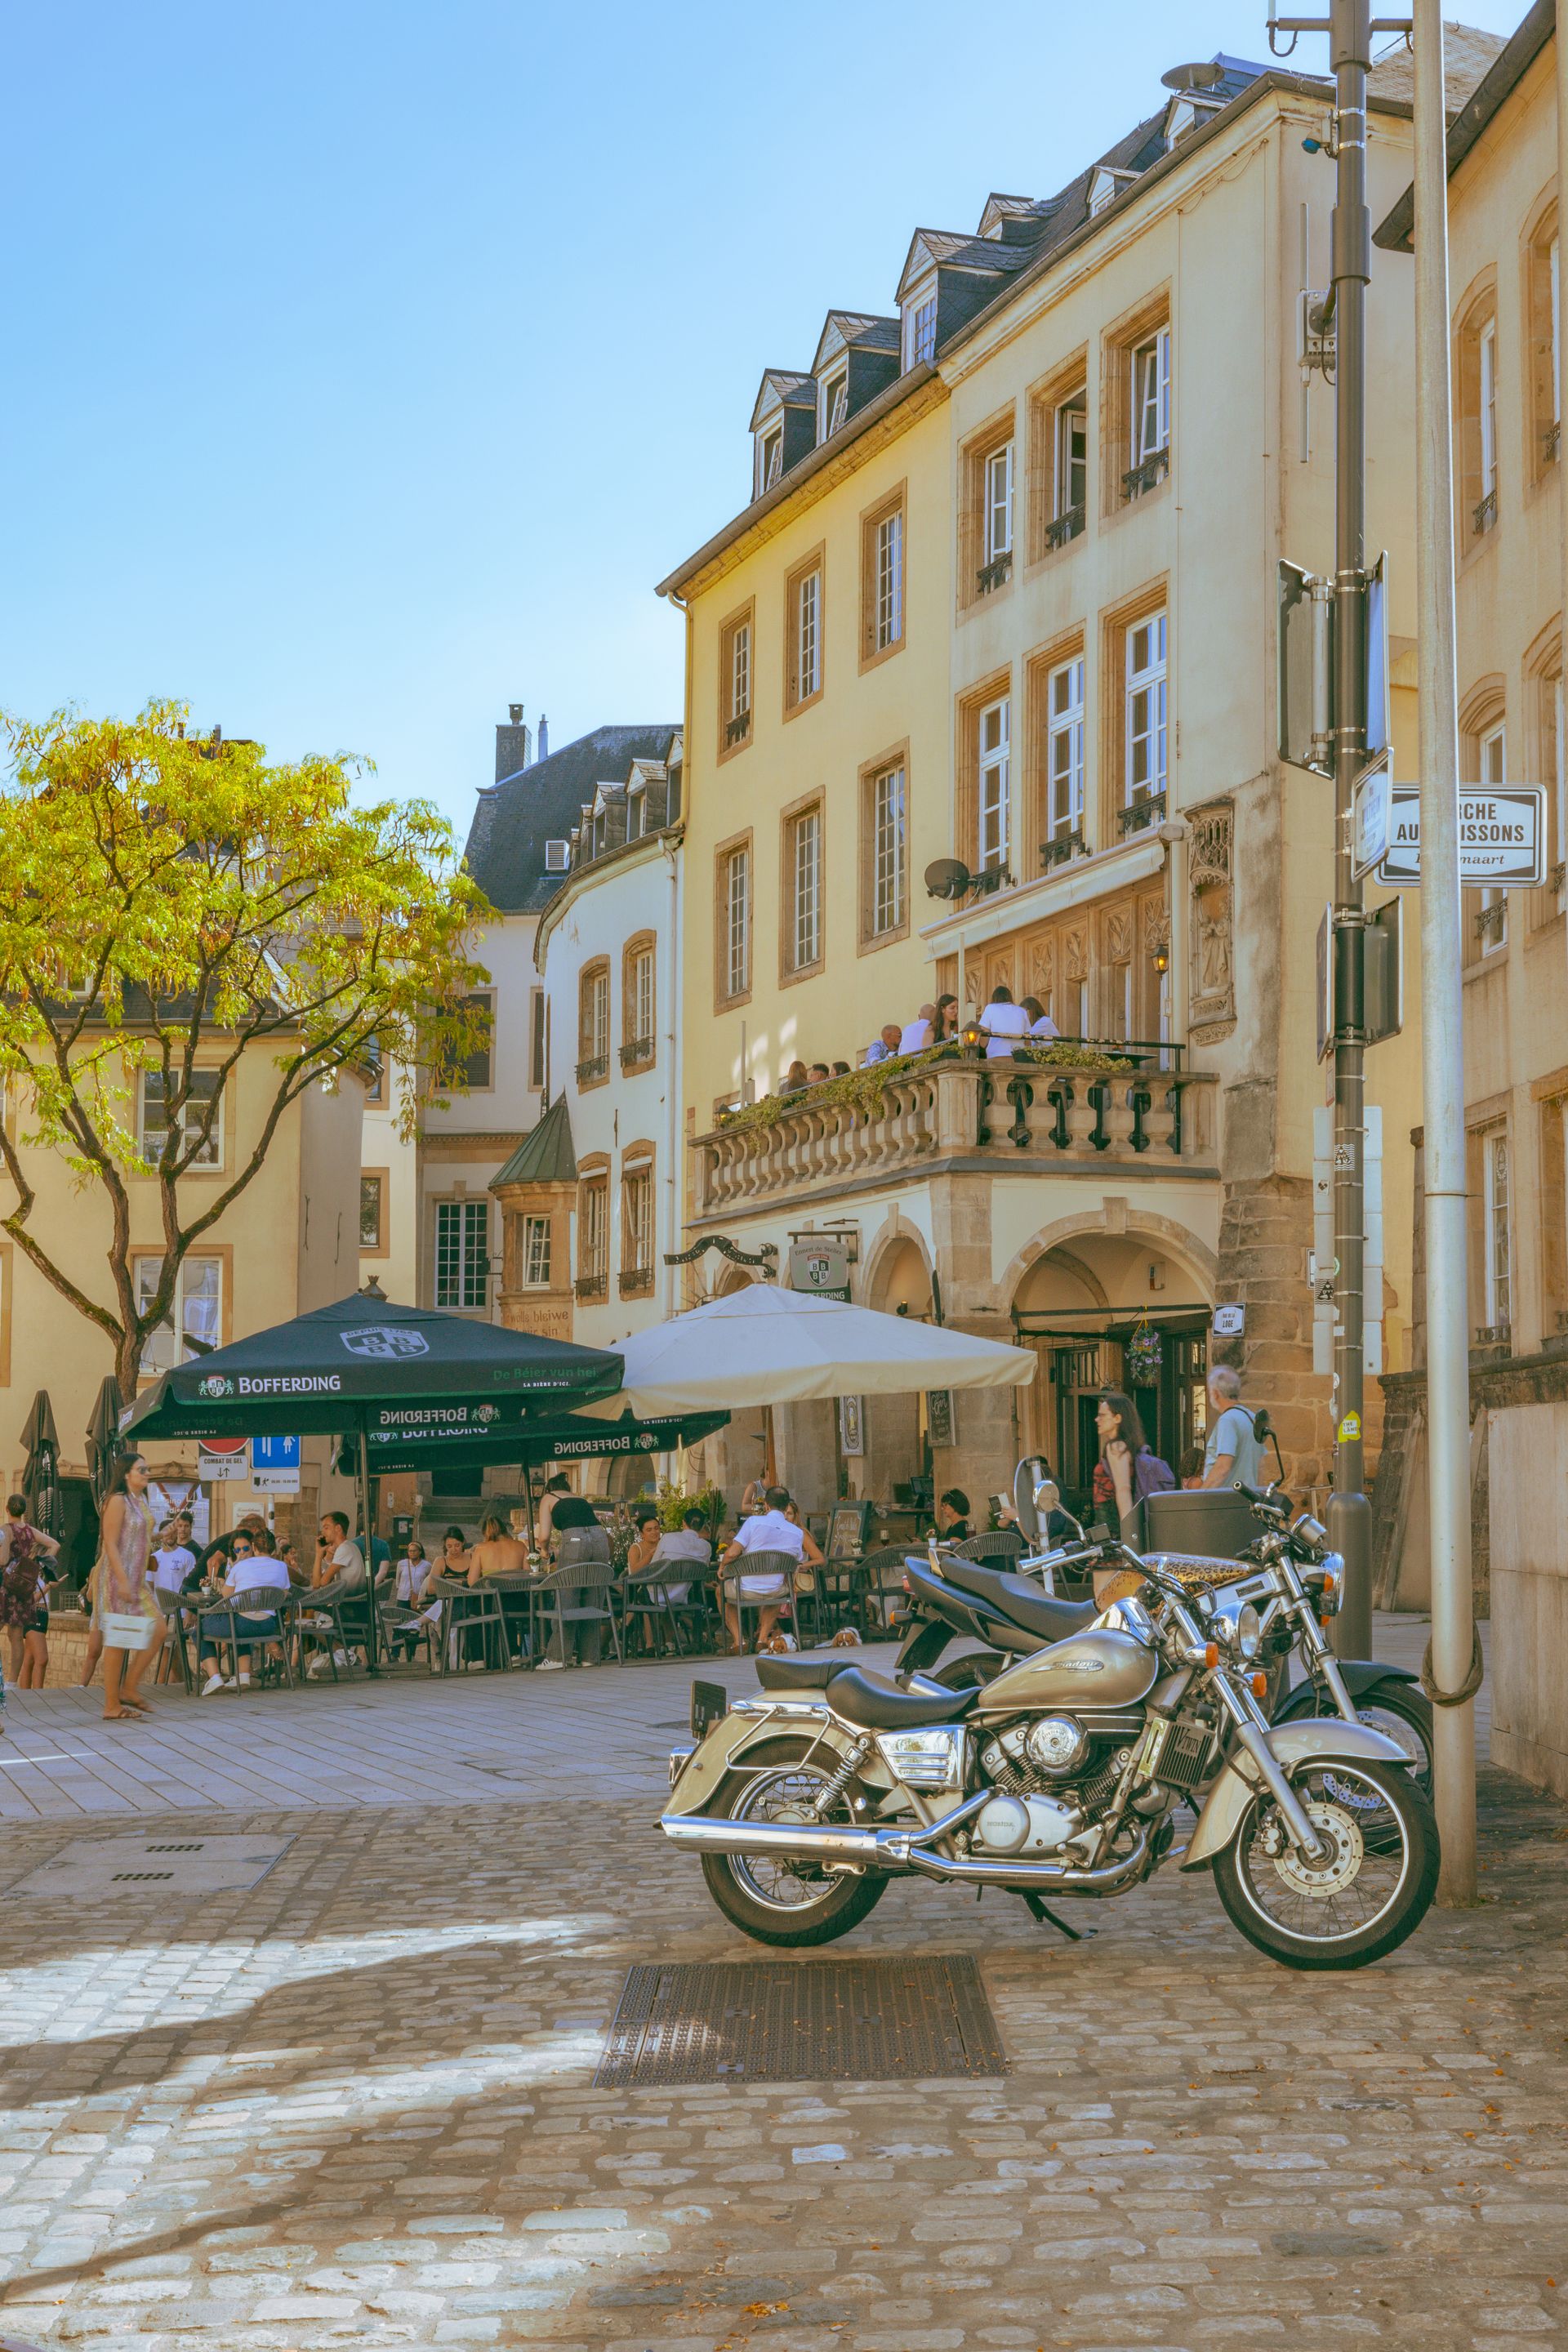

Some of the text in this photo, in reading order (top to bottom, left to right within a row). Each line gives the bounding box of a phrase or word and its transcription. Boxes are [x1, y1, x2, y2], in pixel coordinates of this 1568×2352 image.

[1396, 824, 1525, 842] AU ISSONS
[362, 1336, 411, 1346] B B
[493, 1370, 510, 1380] De
[513, 1366, 546, 1379] Béier
[550, 1368, 573, 1378] vun
[238, 1374, 341, 1394] BOFFERDING
